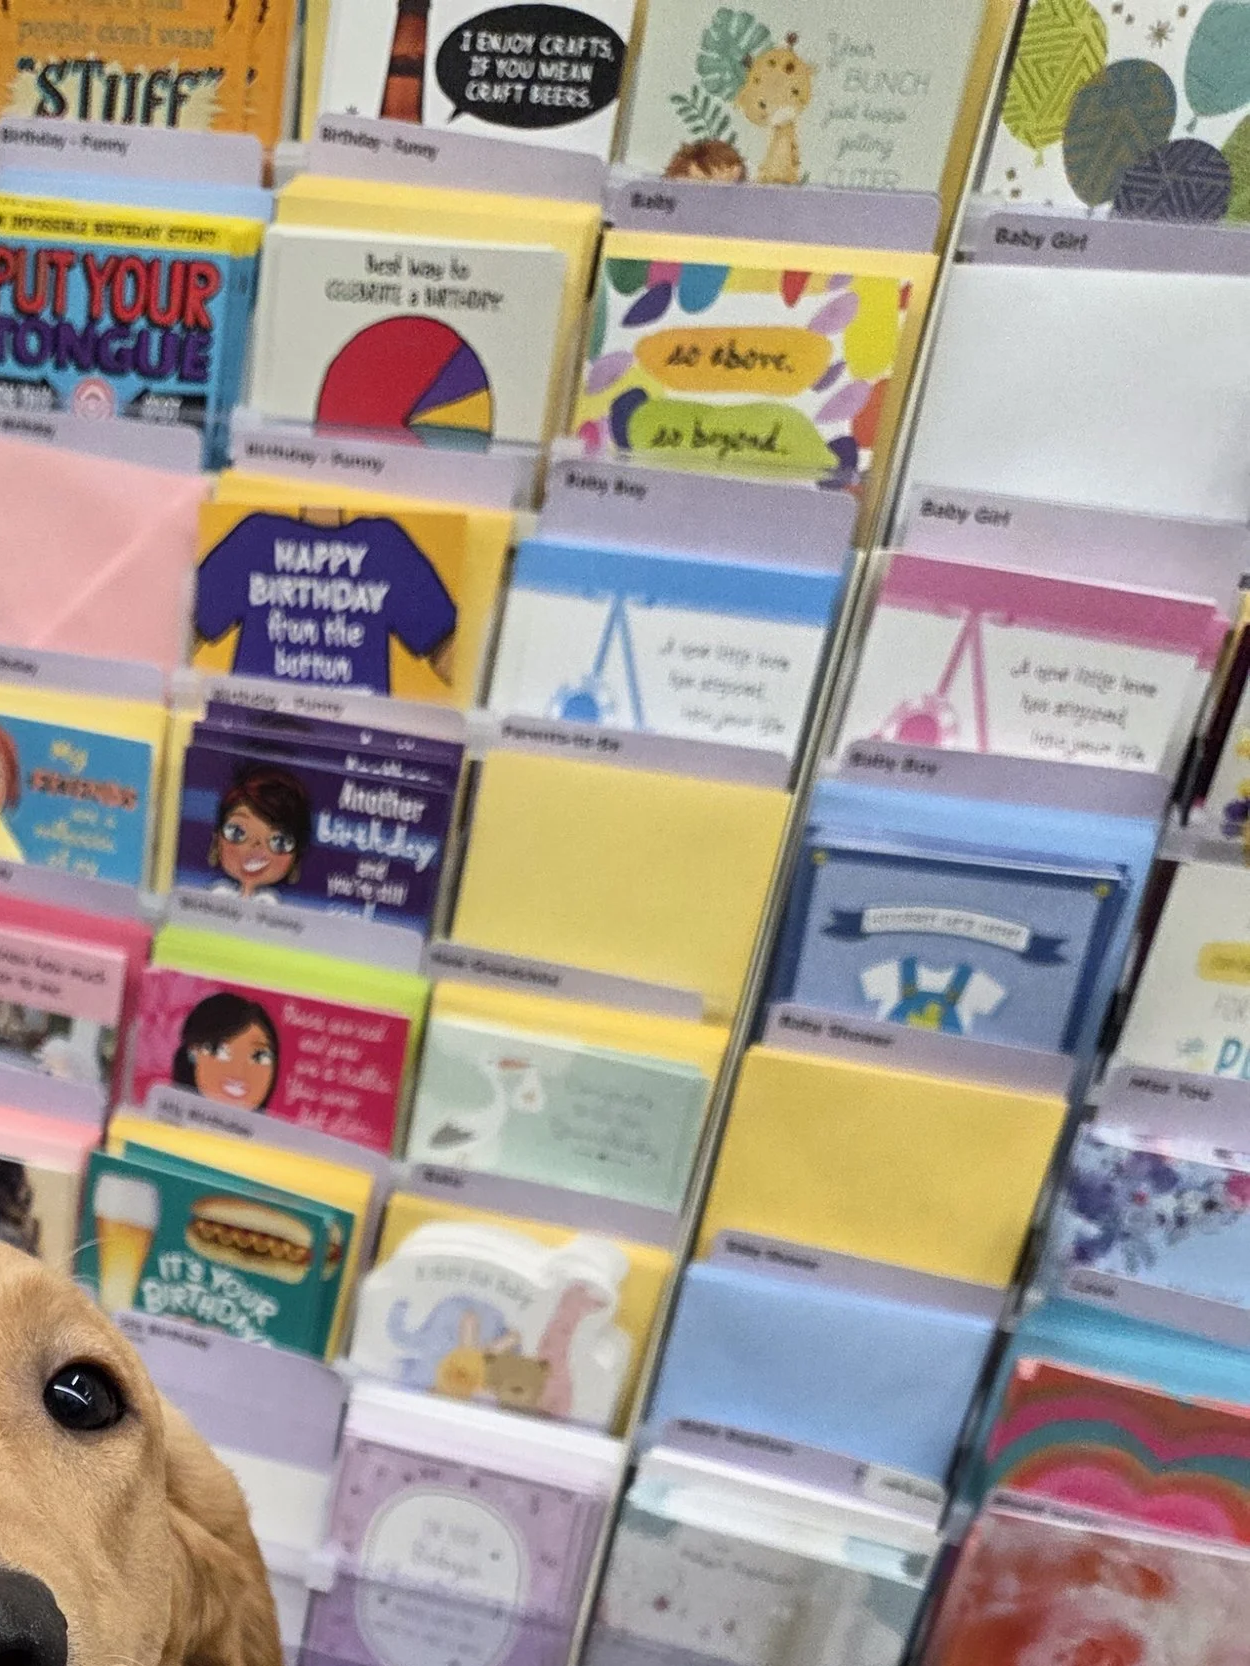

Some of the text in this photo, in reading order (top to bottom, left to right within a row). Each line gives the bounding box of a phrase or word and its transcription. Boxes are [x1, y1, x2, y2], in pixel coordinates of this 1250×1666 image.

[460, 30, 616, 63] I ENJOY CRAFTS,
[468, 55, 594, 84] IF YOU MEAN
[464, 79, 527, 105] CRAFT
[1, 127, 66, 150] Birthday
[80, 133, 130, 156] Funny
[320, 125, 382, 153] Birthday
[394, 138, 440, 163] Funny
[630, 191, 677, 215] Baby
[995, 226, 1088, 252] Baby Girl
[83, 252, 223, 330] YOUR
[919, 500, 1013, 527] Baby Girl
[273, 537, 369, 578] HAPPY
[248, 571, 391, 614] BIRTHDAY
[323, 613, 366, 649] the
